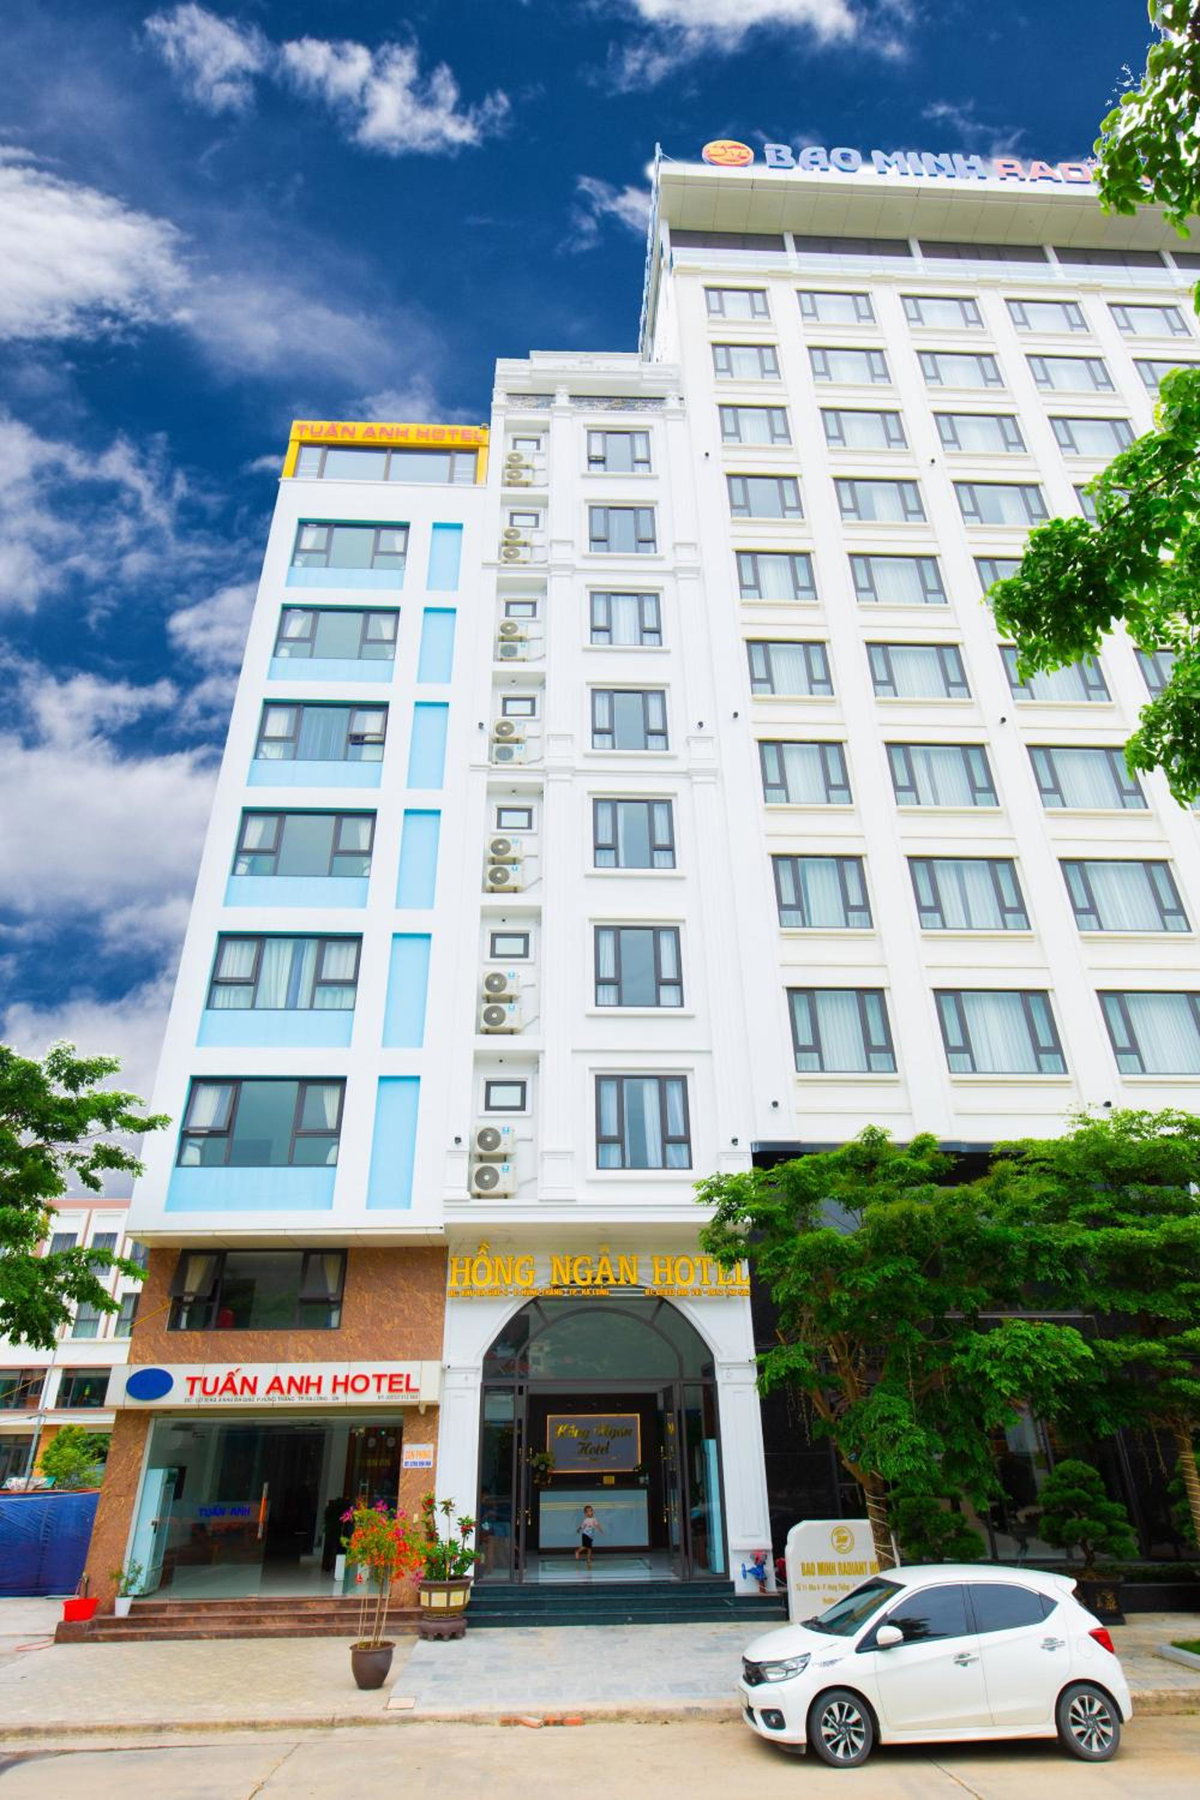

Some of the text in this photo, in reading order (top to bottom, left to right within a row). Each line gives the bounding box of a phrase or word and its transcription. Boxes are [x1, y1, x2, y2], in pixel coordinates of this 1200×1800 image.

[871, 149, 987, 180] MINH
[992, 158, 1094, 184] RAD
[362, 425, 409, 439] ANH
[416, 427, 485, 443] HOTEL
[450, 1238, 536, 1287] HỒNG
[550, 1244, 638, 1286] NGÂN
[185, 1368, 421, 1396] TUẤN ANH HOTEL
